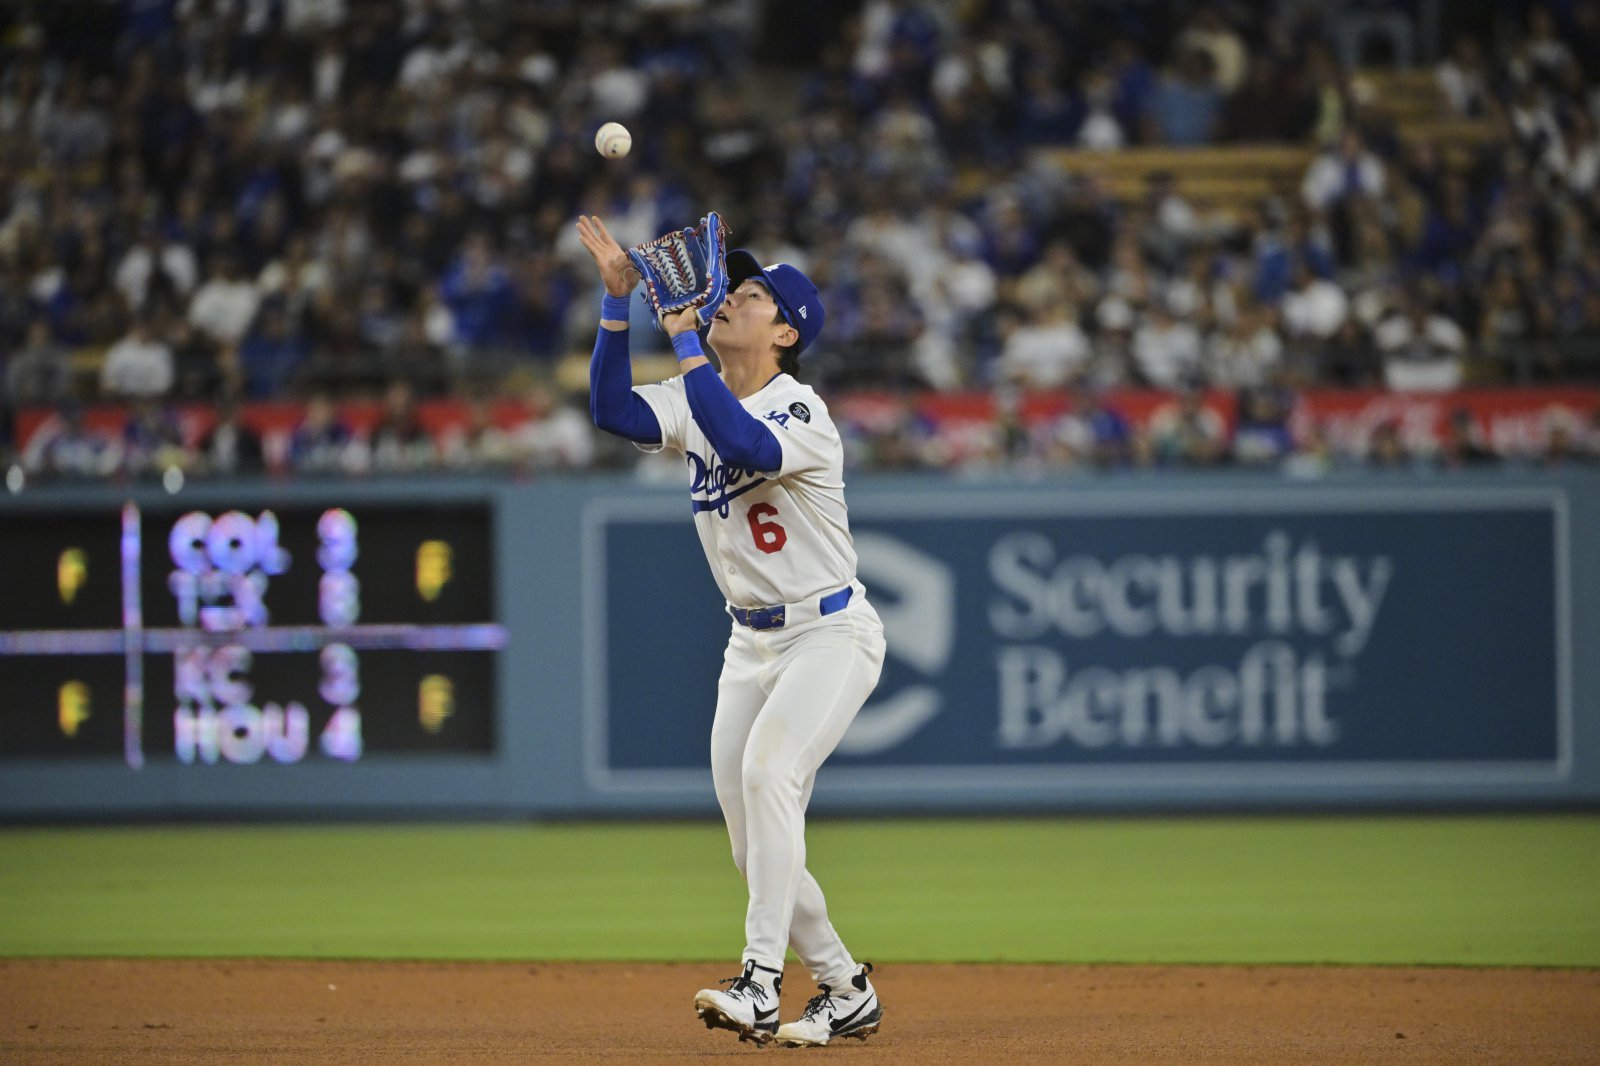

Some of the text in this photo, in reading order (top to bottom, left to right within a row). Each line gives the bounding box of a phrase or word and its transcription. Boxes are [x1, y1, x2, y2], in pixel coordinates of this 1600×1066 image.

[686, 451, 756, 519] Ddge
[746, 502, 788, 554] 6
[988, 530, 1394, 657] Security
[996, 640, 1340, 748] Benefit
[173, 701, 310, 765] HOU
